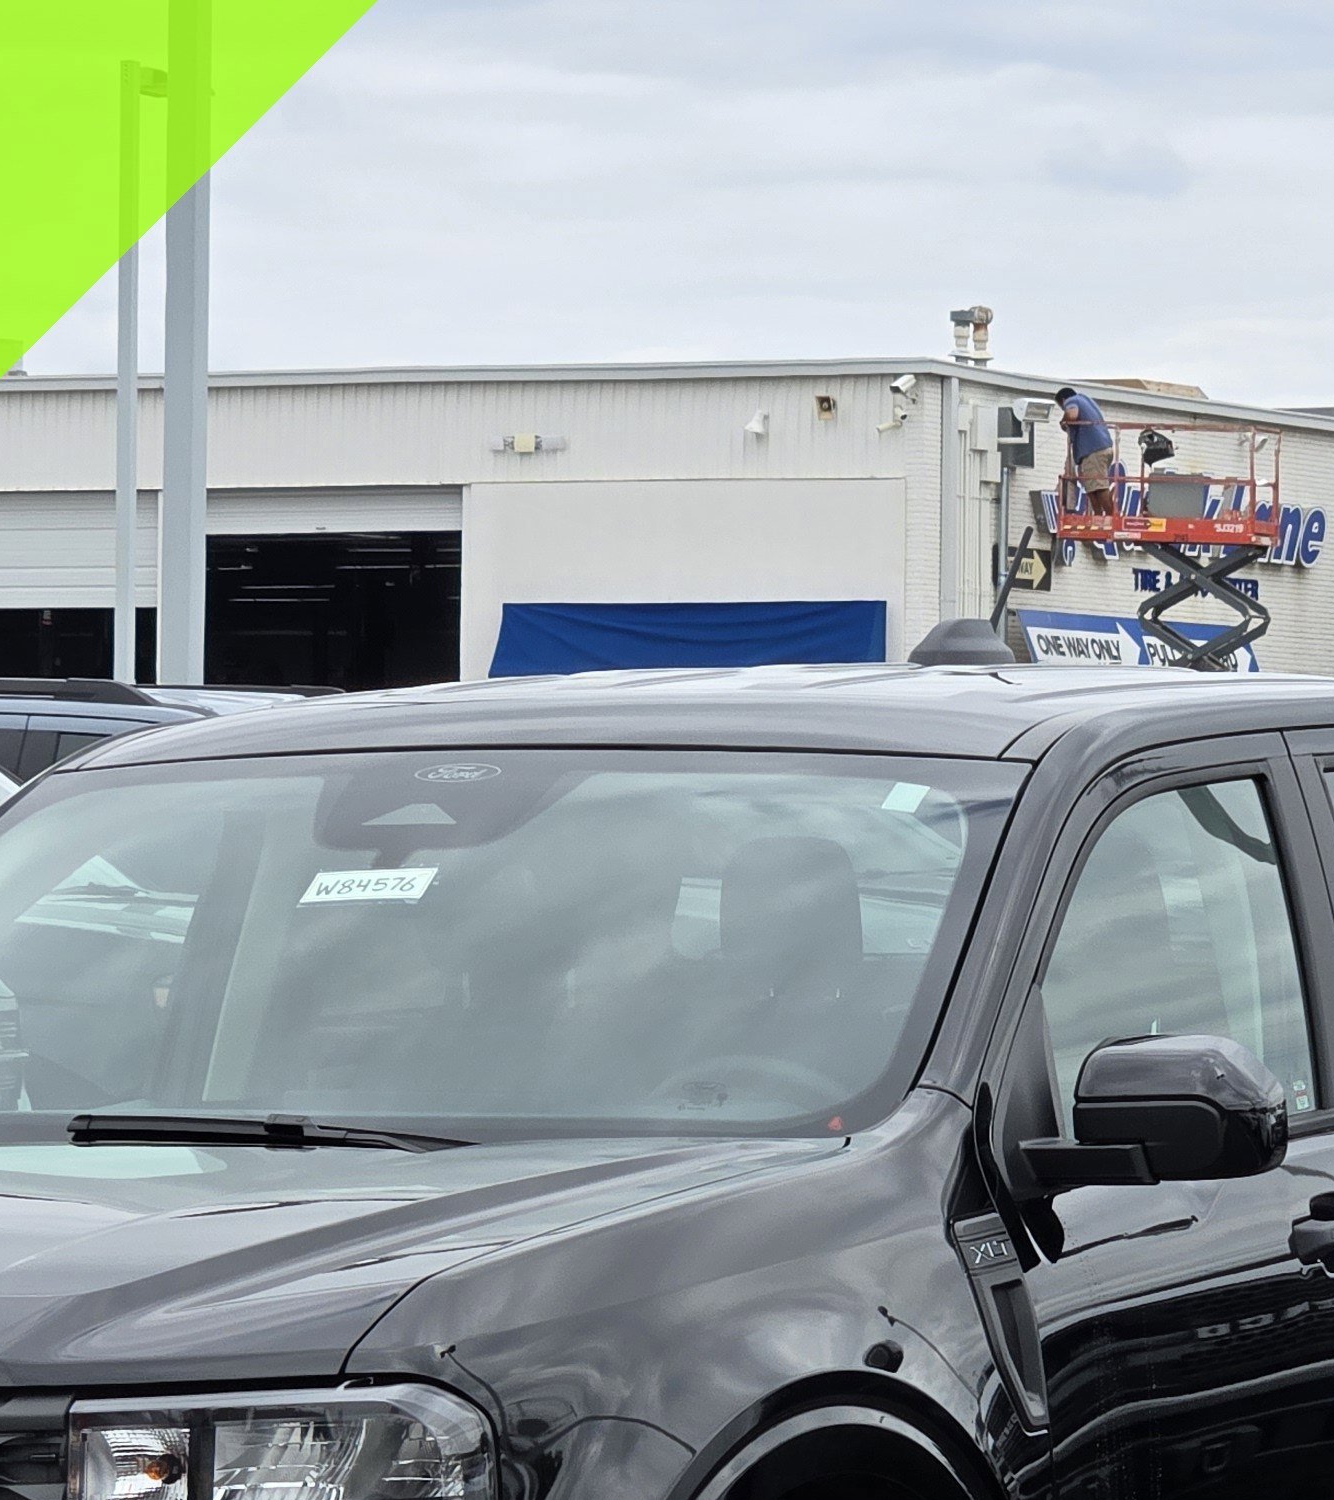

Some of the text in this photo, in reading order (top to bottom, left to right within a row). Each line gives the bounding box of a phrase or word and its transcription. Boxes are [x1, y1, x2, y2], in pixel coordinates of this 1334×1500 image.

[1037, 633, 1122, 661] ONE WAY ONLY
[316, 876, 418, 897] W84576
[970, 1240, 1007, 1264] XLT
